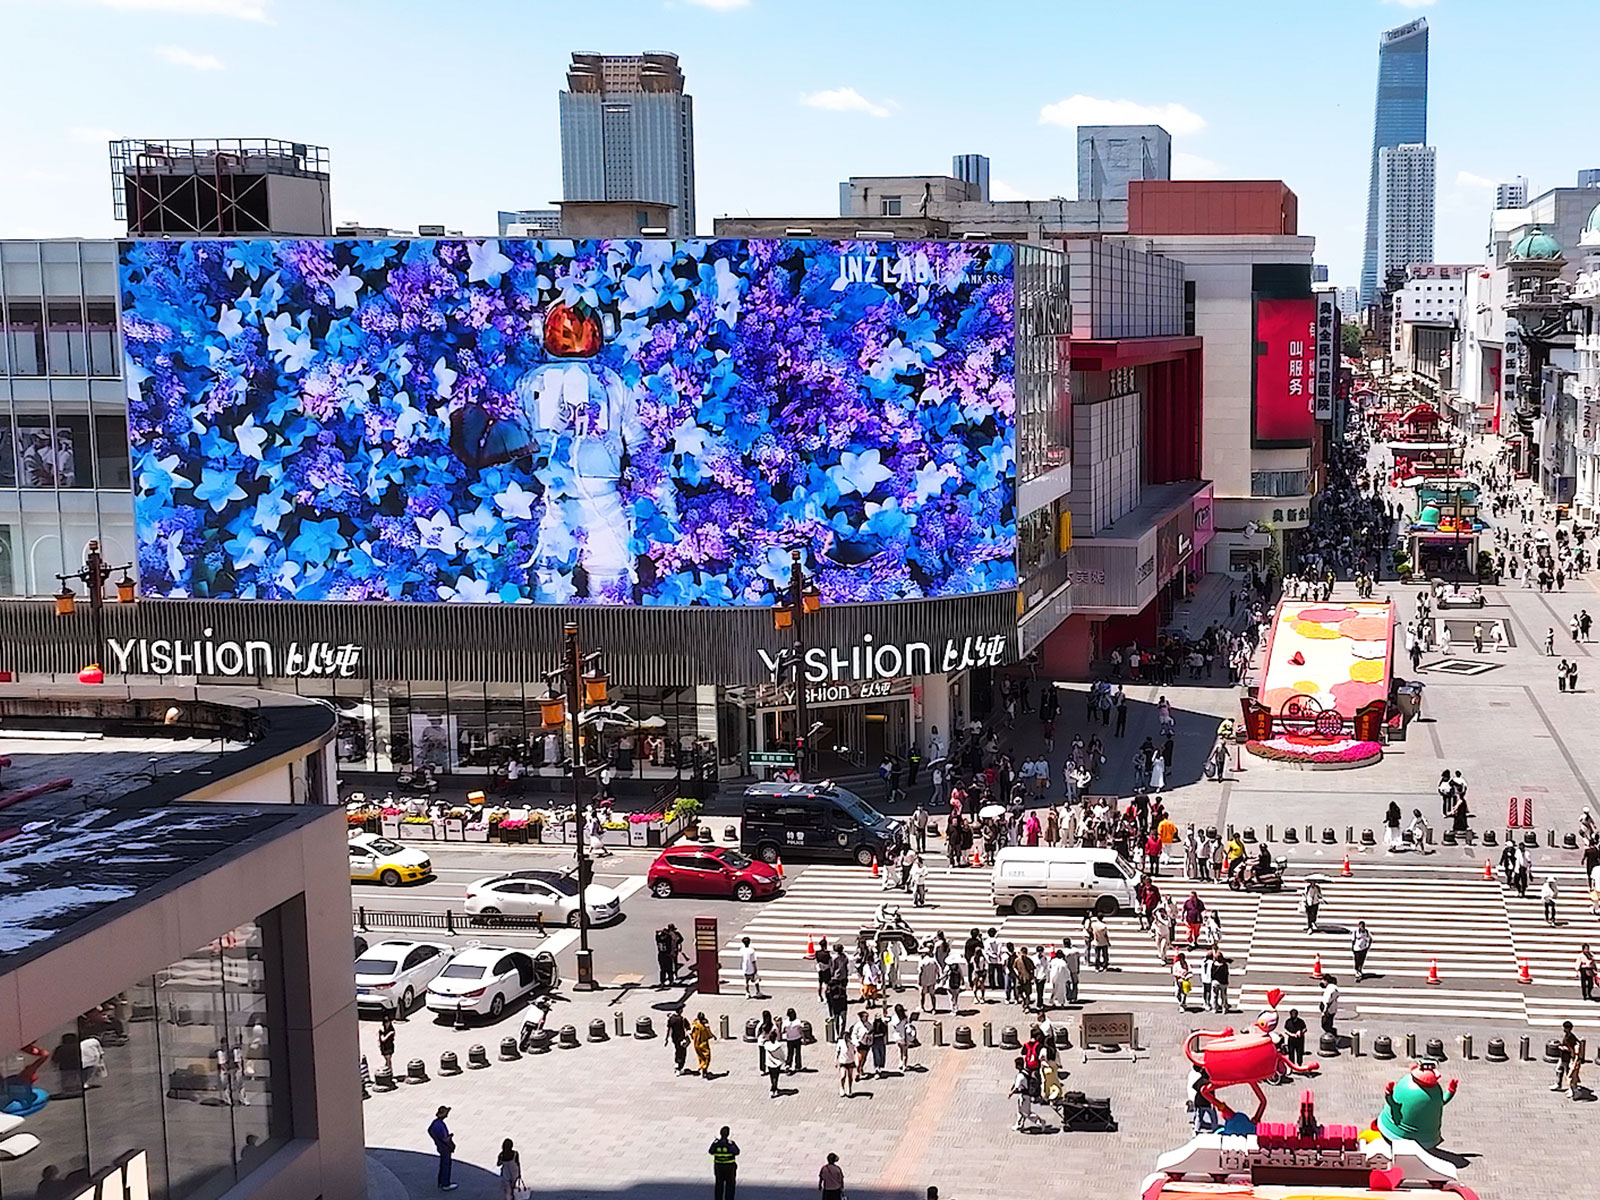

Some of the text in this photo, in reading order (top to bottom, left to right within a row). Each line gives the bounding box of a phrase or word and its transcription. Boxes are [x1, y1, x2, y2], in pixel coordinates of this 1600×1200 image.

[1288, 340, 1304, 396] 叫服务
[1317, 300, 1333, 412] 奥新全民口腔医院
